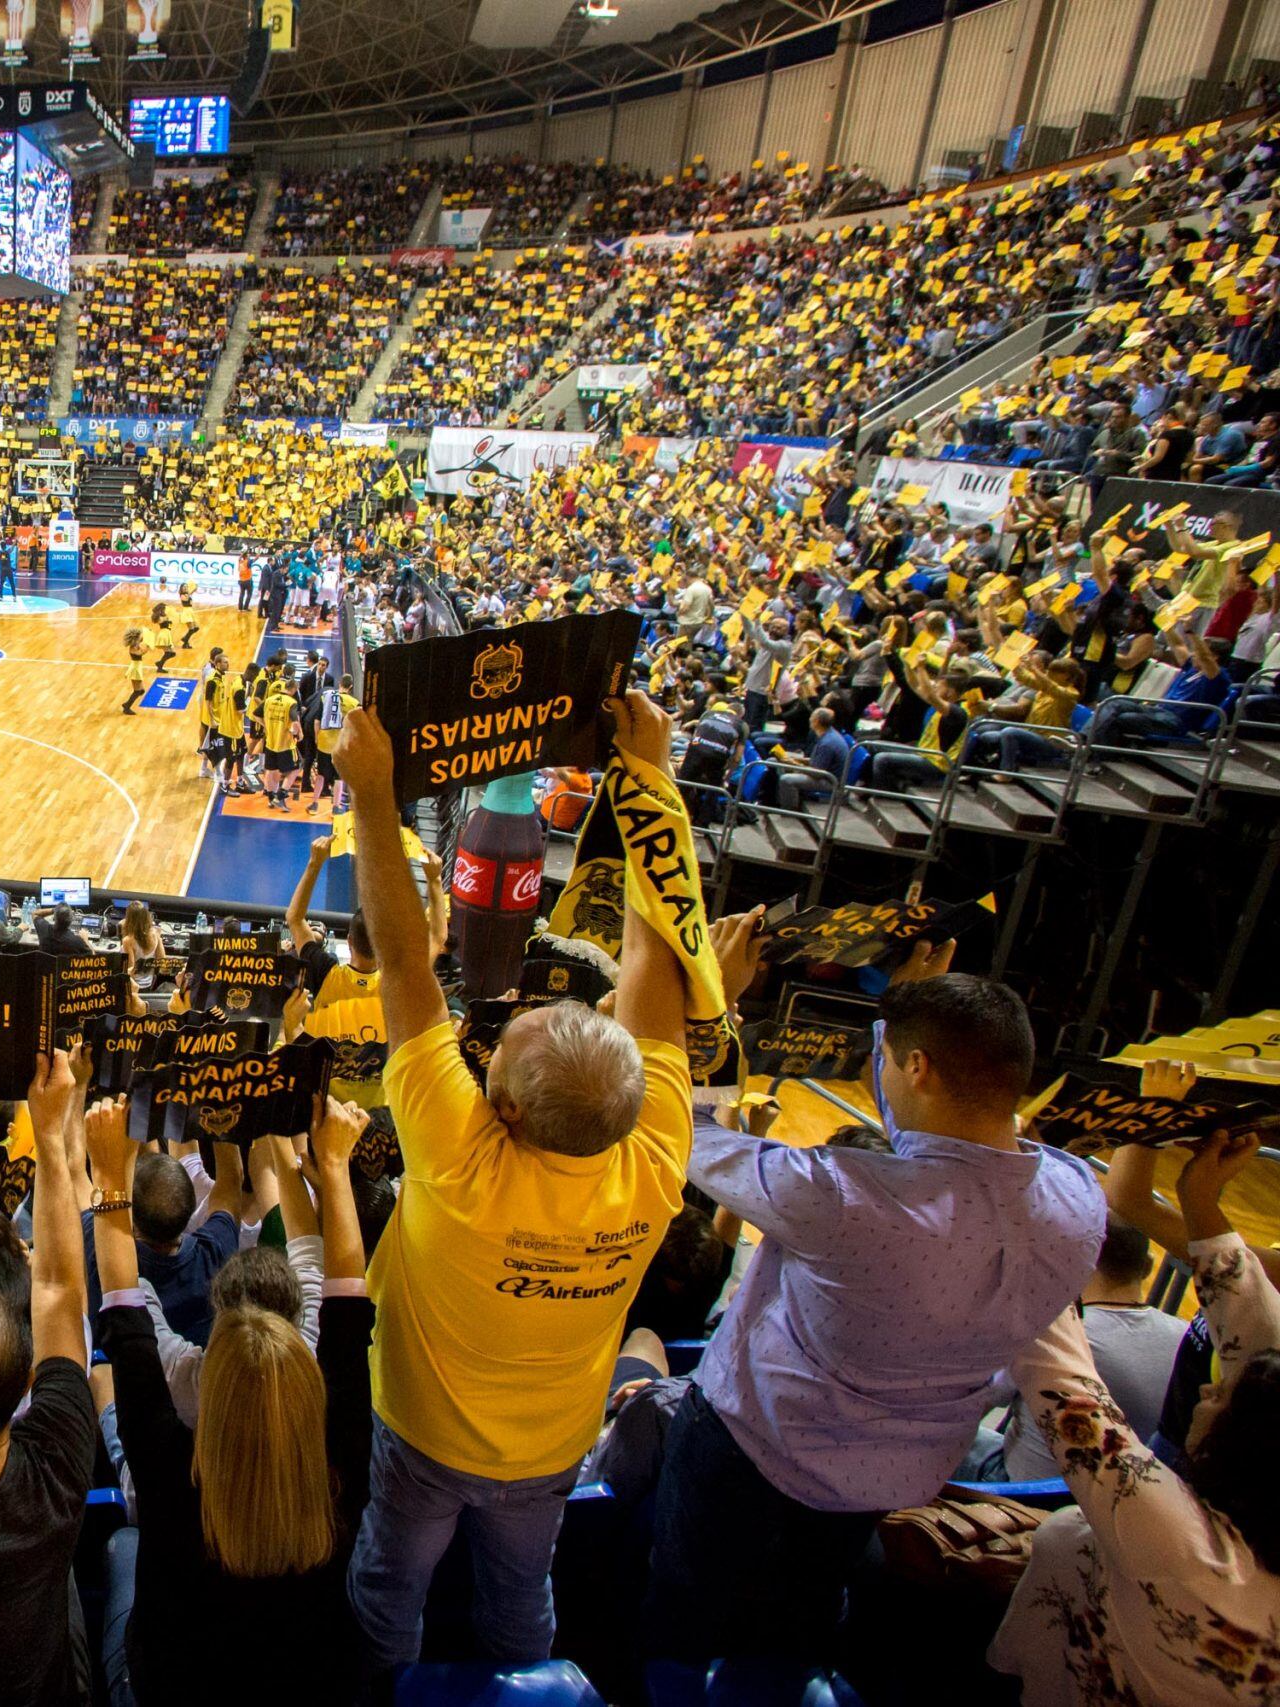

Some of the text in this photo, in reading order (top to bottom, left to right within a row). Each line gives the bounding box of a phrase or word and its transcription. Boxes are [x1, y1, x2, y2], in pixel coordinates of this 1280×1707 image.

[45, 90, 75, 103] DXT
[96, 553, 148, 567] endesa
[153, 555, 235, 576] endesa
[410, 694, 574, 754] CANARIAS!
[204, 969, 284, 987] CANARIAS!
[58, 995, 116, 1014] CANARIAS!
[154, 1073, 296, 1106] CANARIAS!
[505, 1236, 522, 1248] life
[593, 1220, 650, 1245] Tenerife
[541, 1277, 627, 1300] AirEuropa
